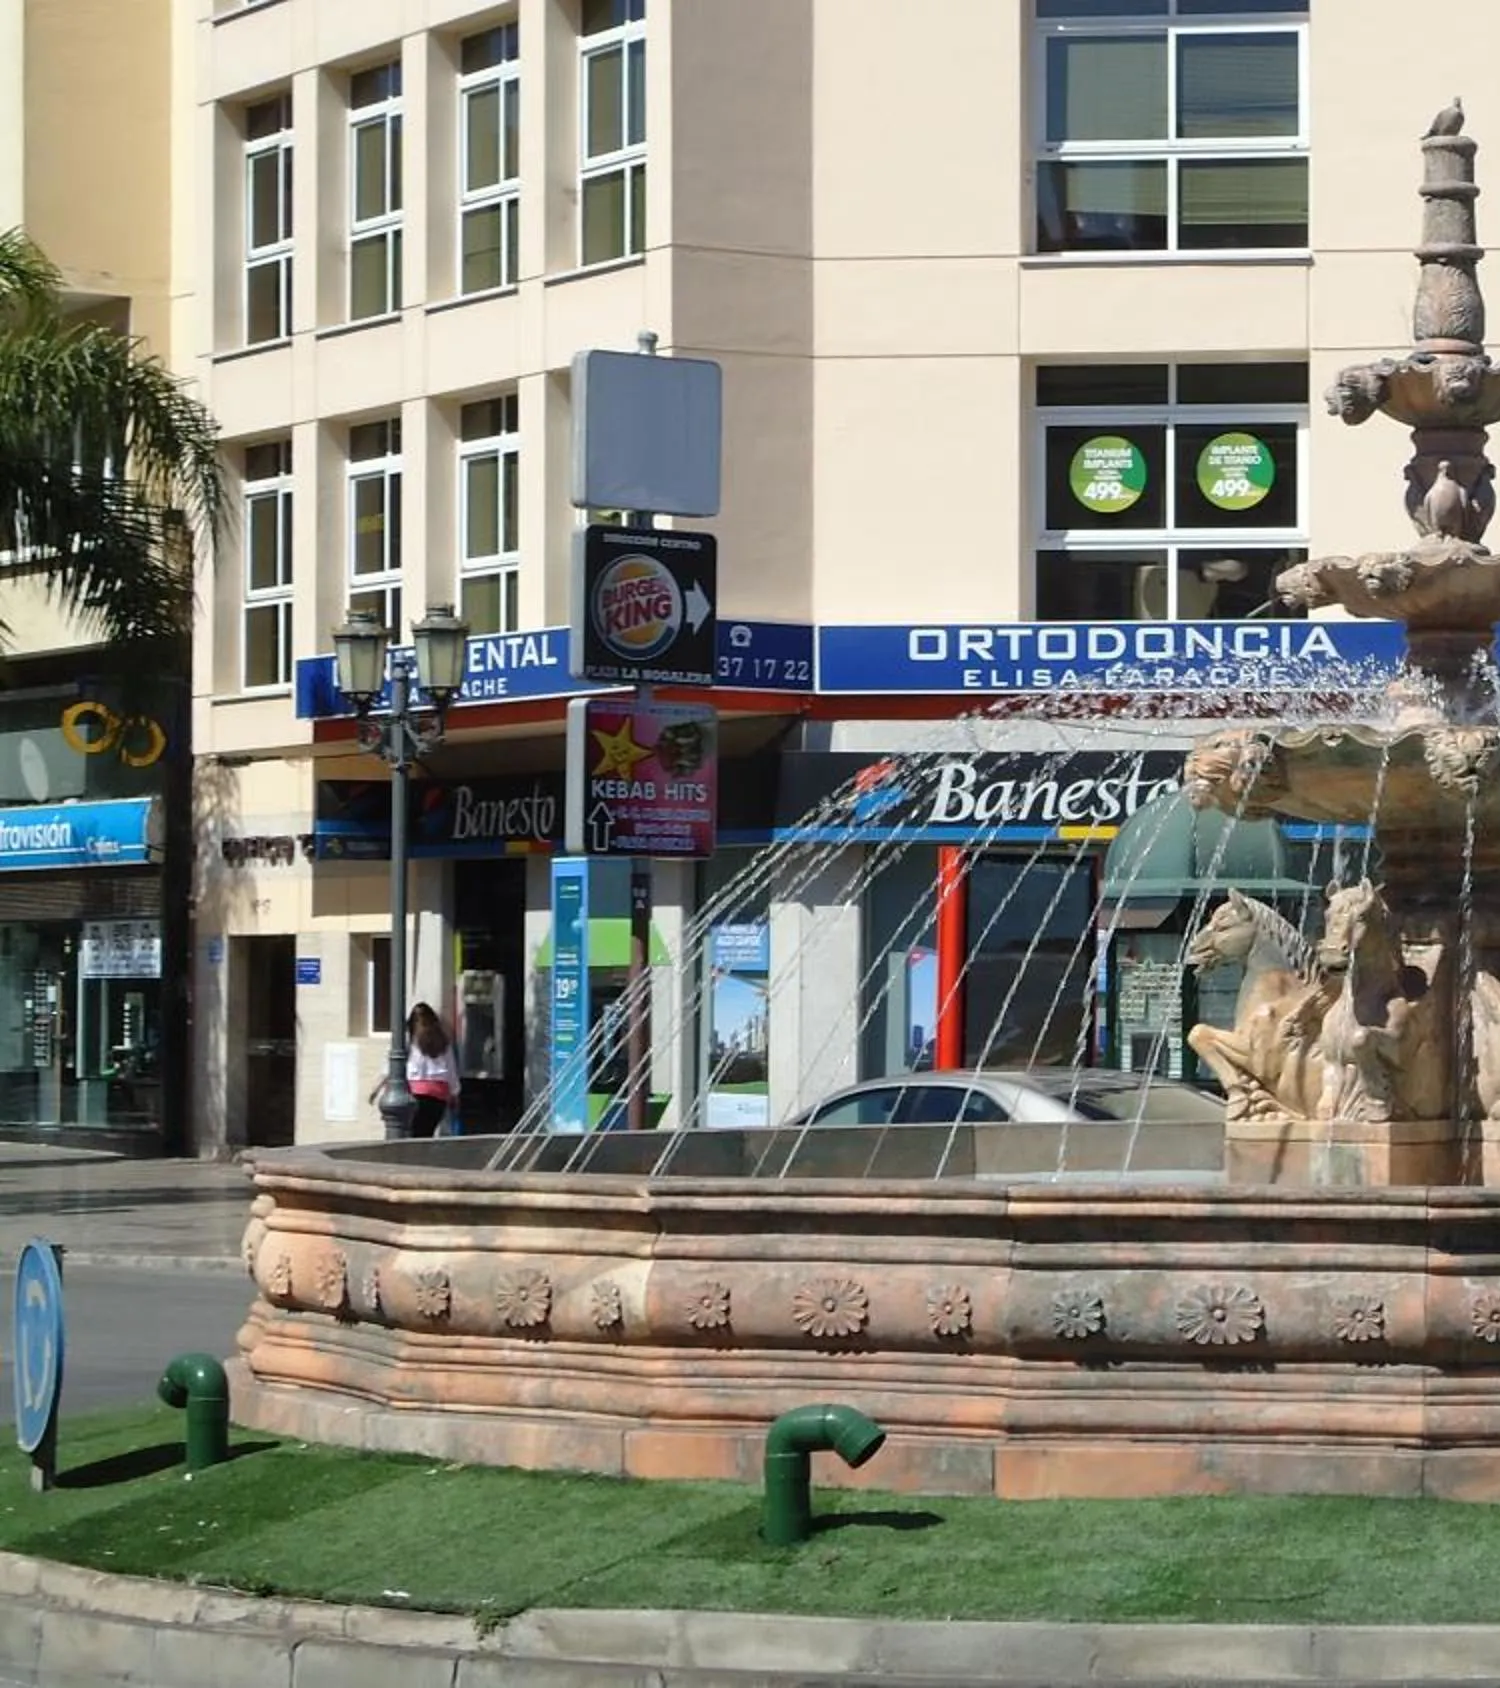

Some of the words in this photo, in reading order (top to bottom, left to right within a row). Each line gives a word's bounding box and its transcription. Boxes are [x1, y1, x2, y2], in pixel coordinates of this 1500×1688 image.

[605, 593, 672, 636] KING
[466, 636, 558, 674] ENTAL
[908, 626, 1339, 662] ORTODONCIA
[718, 656, 744, 678] 37
[753, 658, 777, 680] 17
[784, 660, 809, 681] 22
[963, 668, 1079, 688] ELISA
[591, 780, 657, 800] KEBAB
[664, 783, 707, 802] HITS
[451, 781, 556, 843] Banesto
